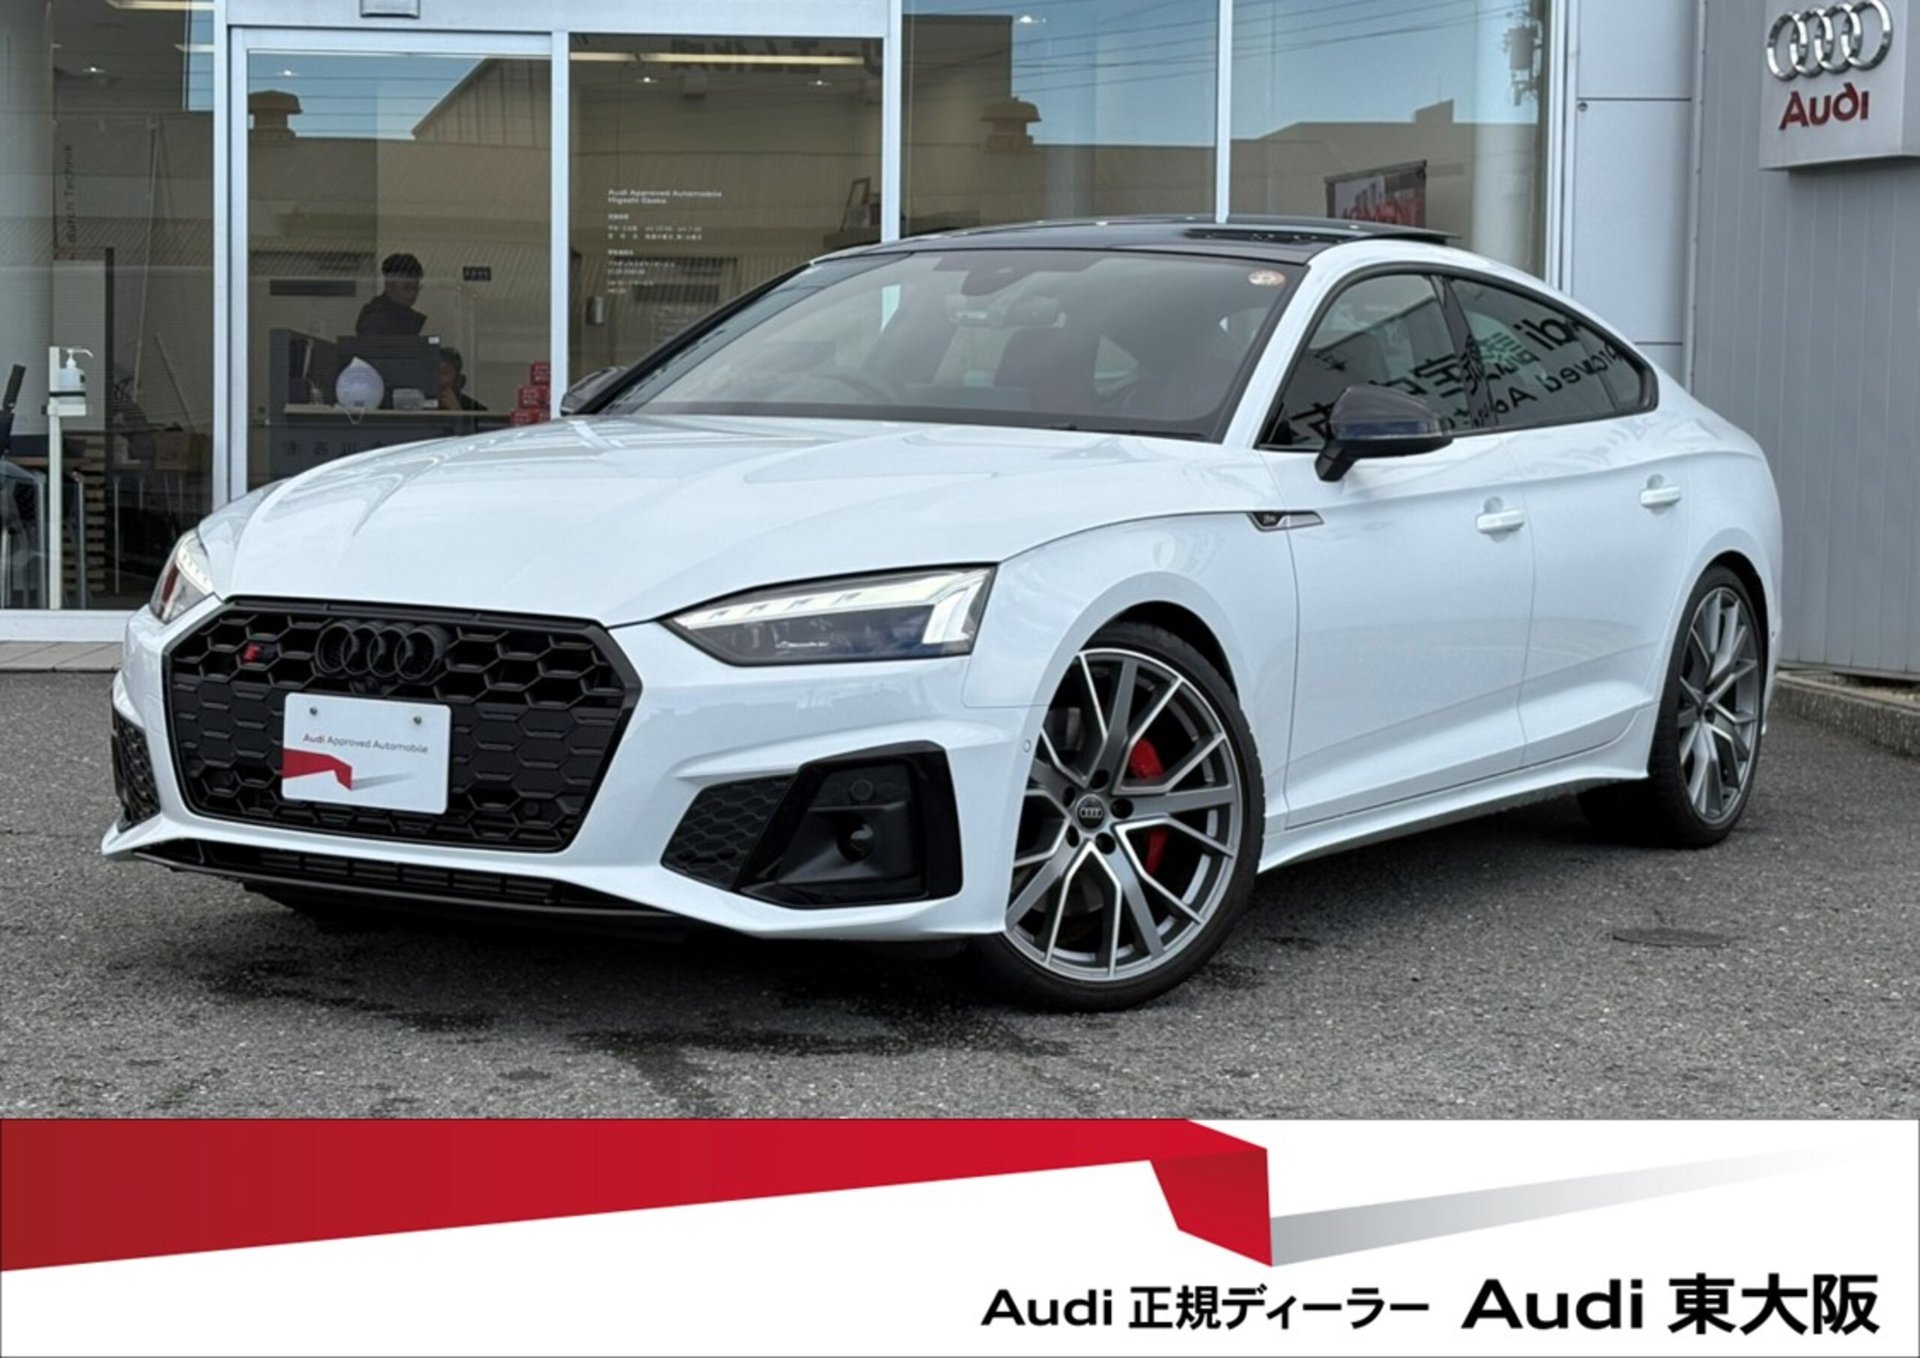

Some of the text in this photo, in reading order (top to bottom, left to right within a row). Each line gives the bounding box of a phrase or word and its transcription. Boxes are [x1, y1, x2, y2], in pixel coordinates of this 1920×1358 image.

[1779, 82, 1869, 130] Audi
[302, 733, 428, 754] Audi Approved Automobile
